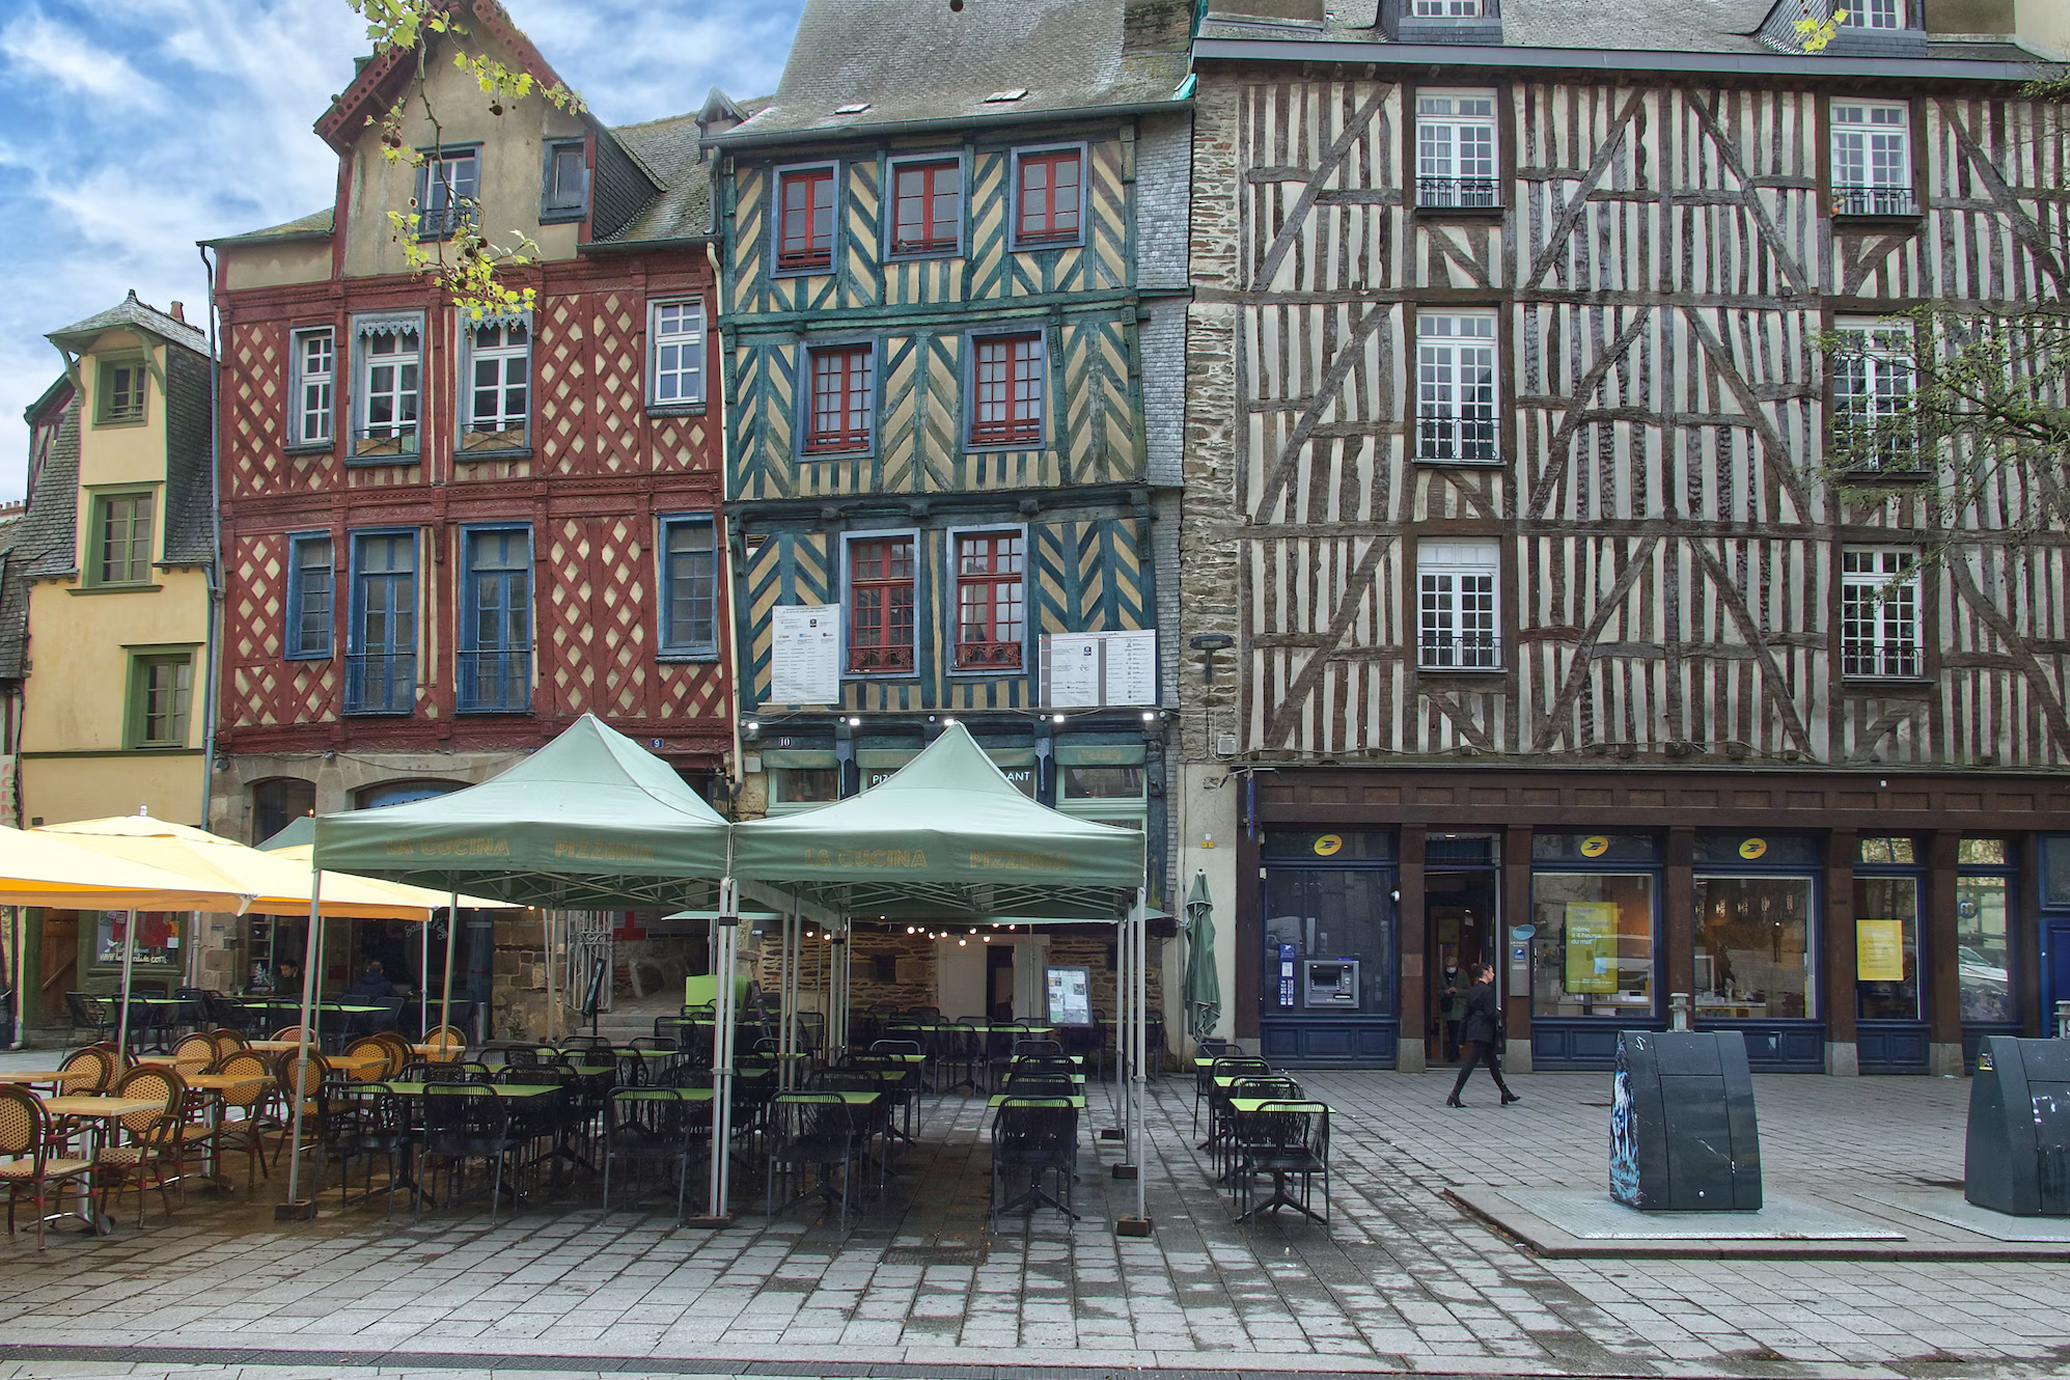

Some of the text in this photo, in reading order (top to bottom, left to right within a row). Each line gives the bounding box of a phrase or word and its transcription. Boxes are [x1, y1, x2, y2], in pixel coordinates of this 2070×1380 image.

[780, 738, 790, 746] 10
[386, 838, 655, 861] LA CUCINA PIZZERIA
[805, 849, 1069, 870] LA CUCINA PIZZERIA
